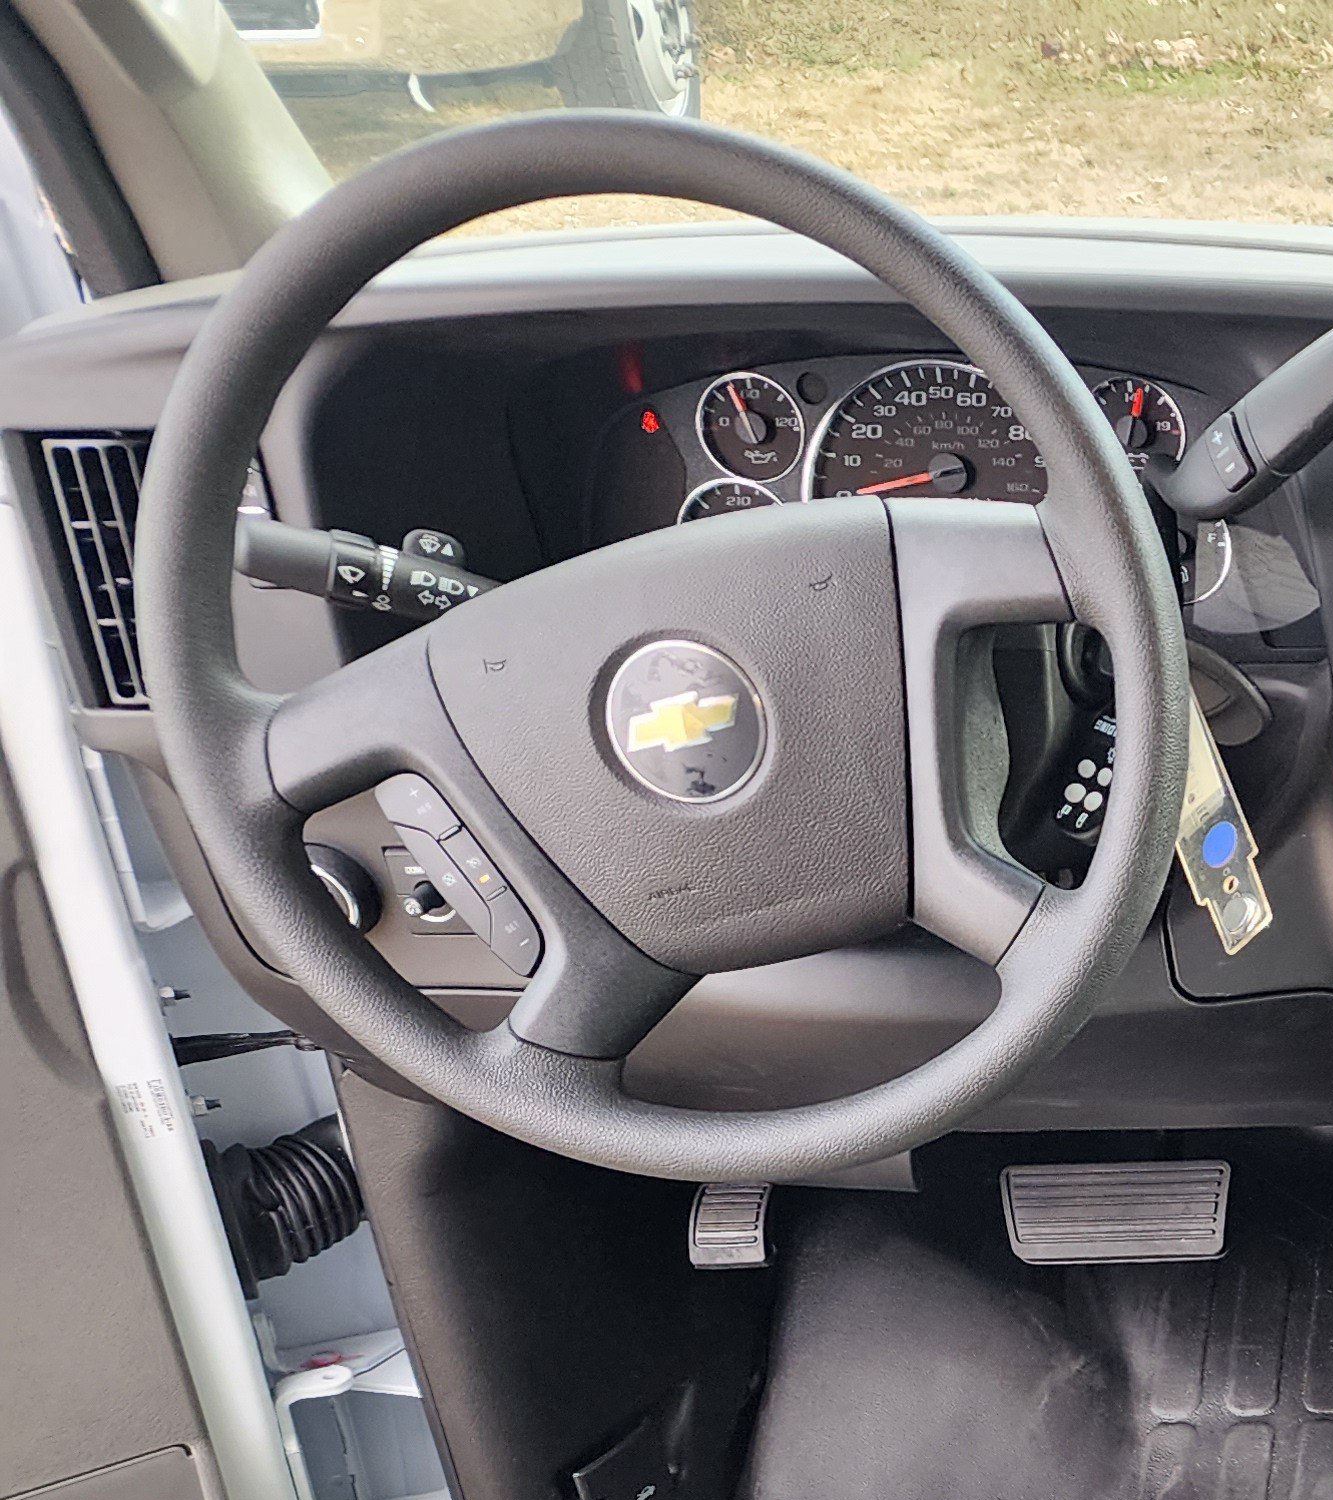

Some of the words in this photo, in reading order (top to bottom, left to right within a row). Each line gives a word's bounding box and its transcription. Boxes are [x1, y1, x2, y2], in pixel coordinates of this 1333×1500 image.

[894, 390, 927, 406] 40
[929, 386, 954, 399] 50
[957, 392, 987, 407] 60
[873, 405, 897, 417] 30
[991, 406, 1012, 418] 70
[718, 417, 730, 427] 0
[775, 417, 798, 427] 120
[1155, 421, 1171, 432] 19
[852, 424, 883, 439] 20
[895, 438, 915, 448] 40
[931, 440, 965, 450] km/h
[978, 438, 1000, 449] 120
[844, 455, 861, 467] 10
[726, 496, 751, 506] 210
